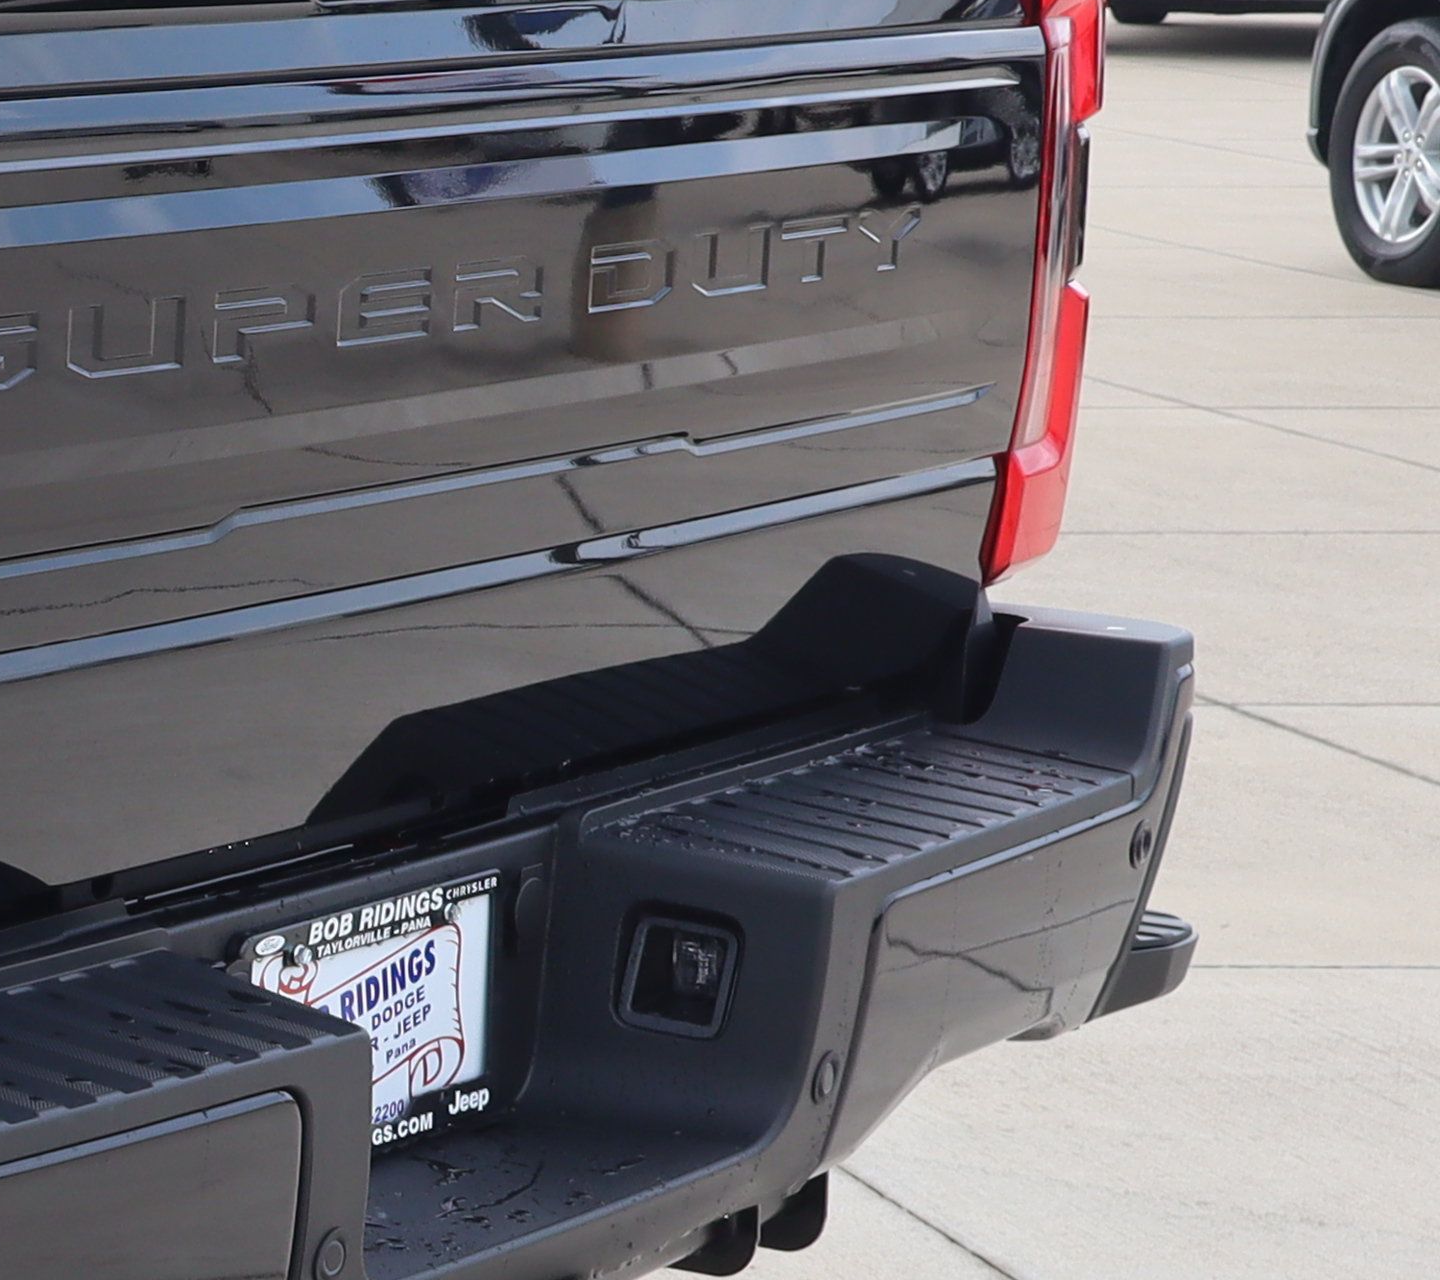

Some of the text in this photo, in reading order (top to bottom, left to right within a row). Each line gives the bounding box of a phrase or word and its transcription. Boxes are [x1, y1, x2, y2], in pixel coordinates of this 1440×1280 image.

[587, 202, 924, 314] DUTY
[445, 876, 498, 900] CHRYSLER
[308, 886, 444, 946] BOB RIDINGS
[315, 927, 392, 959] TAYLORVILLE
[400, 916, 432, 939] PANA
[339, 938, 437, 1022] RIDINGS
[371, 985, 426, 1031] DODGE
[393, 1003, 432, 1040] JEEP
[386, 1037, 417, 1064] Pana
[448, 1087, 490, 1116] Jeep
